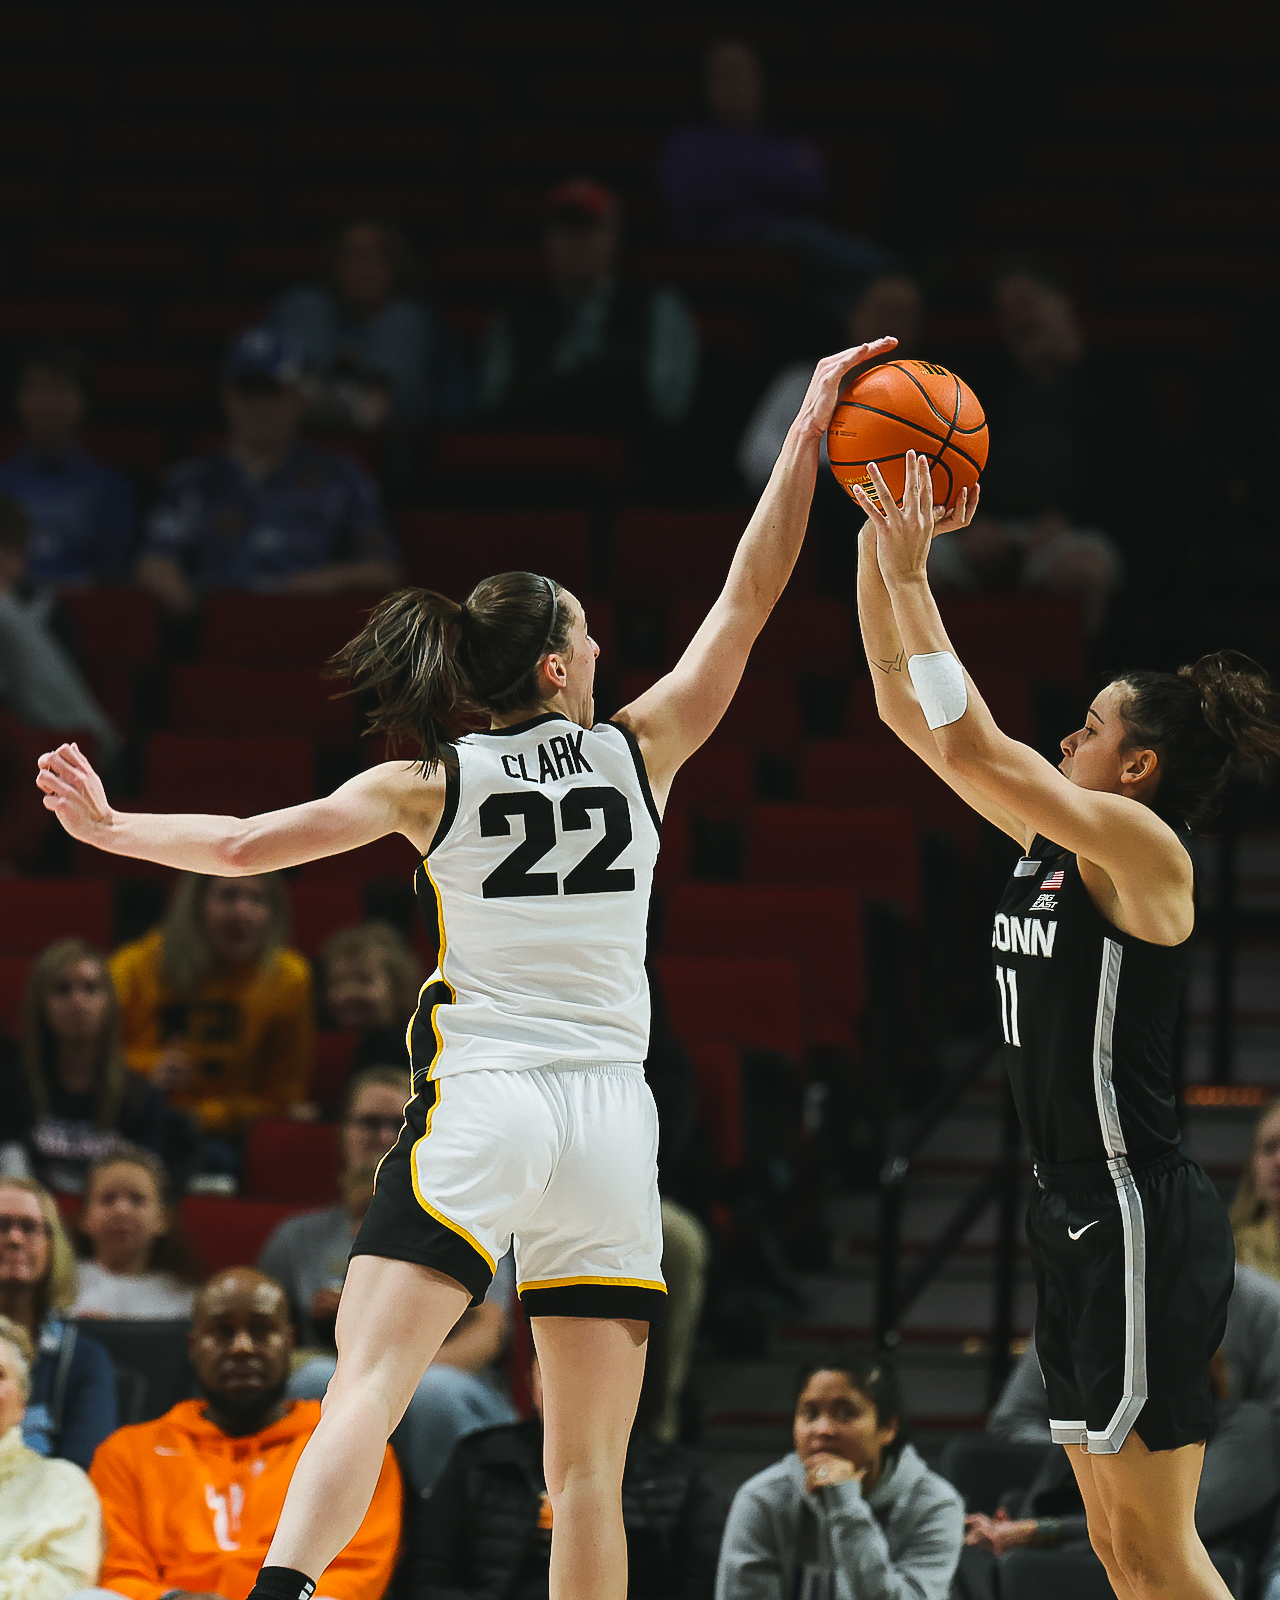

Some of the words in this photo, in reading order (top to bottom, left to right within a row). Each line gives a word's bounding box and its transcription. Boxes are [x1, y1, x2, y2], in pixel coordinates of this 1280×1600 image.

[501, 730, 593, 784] CLARK
[479, 786, 635, 899] 22
[1032, 900, 1058, 908] EAST
[1037, 893, 1055, 901] BIG
[992, 912, 1058, 958] ONN
[996, 965, 1021, 1047] 11
